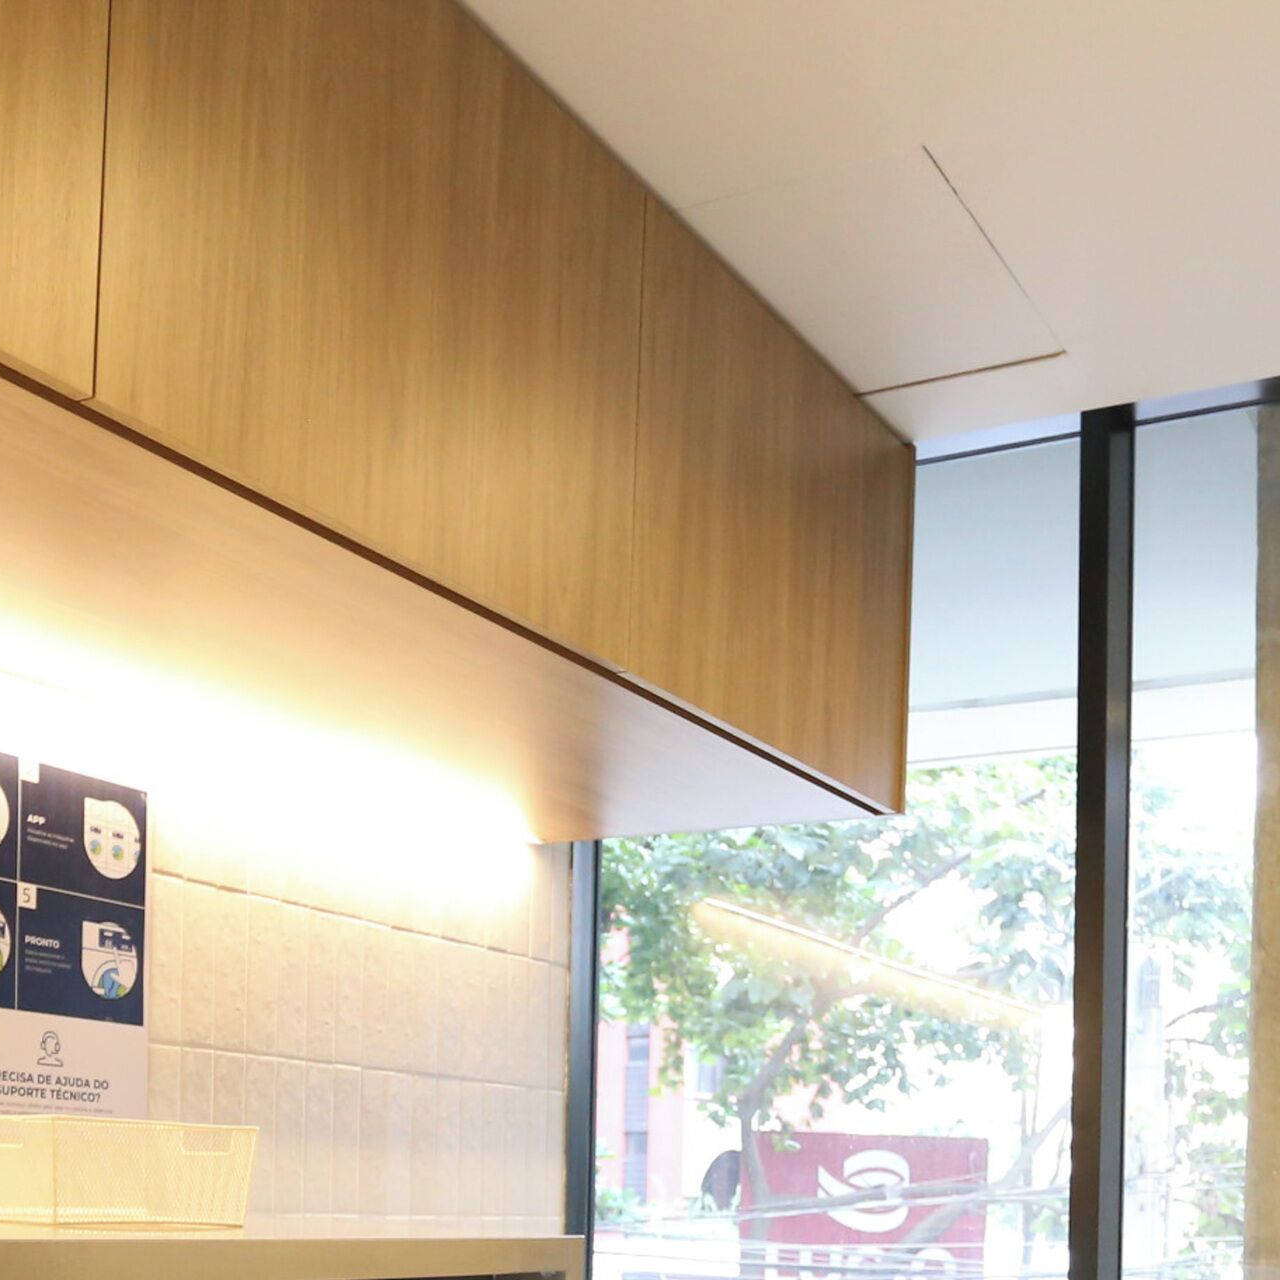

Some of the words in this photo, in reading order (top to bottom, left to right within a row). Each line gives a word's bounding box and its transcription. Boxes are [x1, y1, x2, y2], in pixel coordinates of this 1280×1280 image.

[22, 888, 31, 904] 5
[24, 934, 61, 950] PRONTO
[37, 1074, 52, 1085] DE
[55, 1076, 90, 1089] AJUDA
[93, 1079, 109, 1090] DO
[50, 1088, 101, 1103] TÉCNICO?
